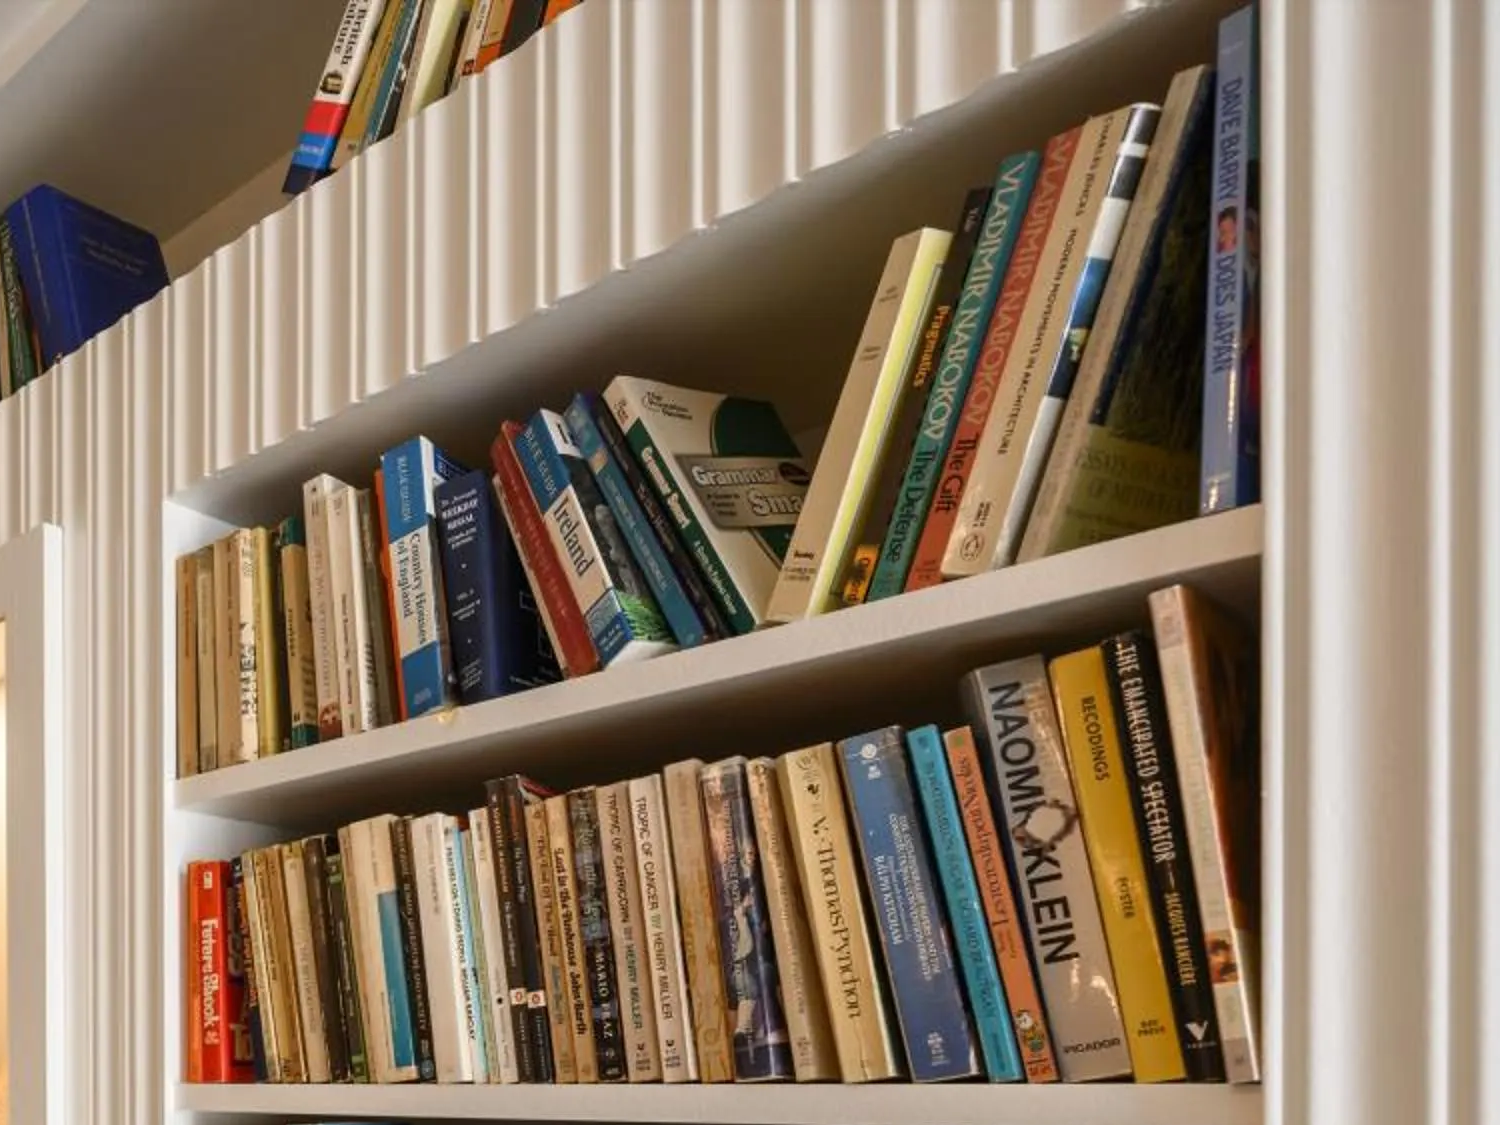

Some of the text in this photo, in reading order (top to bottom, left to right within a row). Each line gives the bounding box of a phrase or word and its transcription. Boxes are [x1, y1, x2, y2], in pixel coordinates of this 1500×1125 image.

[962, 161, 1026, 305] VLADIMIR
[1212, 76, 1242, 375] DAVE BARRY DOES JAPAN
[909, 303, 950, 388] Pragmatics
[932, 139, 1071, 516] VLADIMIR NABOKOV The Gift
[919, 303, 984, 445] NABOKOV
[691, 465, 778, 487] Grammar
[907, 447, 937, 486] The
[552, 494, 594, 580] Ireland
[882, 482, 927, 565] Defense
[396, 556, 414, 620] England
[406, 532, 430, 644] Country Houses
[1078, 694, 1110, 782] RECODINGS
[1112, 642, 1177, 863] THE EMANCIPATED SPECTATOR
[606, 793, 620, 835] TROPIC
[634, 796, 650, 839] TROPIC
[985, 678, 1081, 965] NAOMI KLEIN
[553, 847, 566, 874] Lost
[611, 836, 622, 853] OF
[641, 841, 653, 859] OF
[614, 855, 630, 923] CAPRICORN
[643, 861, 659, 910] CANCER
[561, 909, 578, 967] Funhouse
[815, 843, 867, 1019] Thomas Pynchon
[1163, 891, 1188, 936] JACQUES
[624, 944, 638, 983] HENRY
[652, 931, 667, 971] HENRY
[569, 971, 583, 997] John
[629, 986, 643, 1028] MILLER
[658, 974, 673, 1019] MILLER
[572, 999, 587, 1035] Barth
